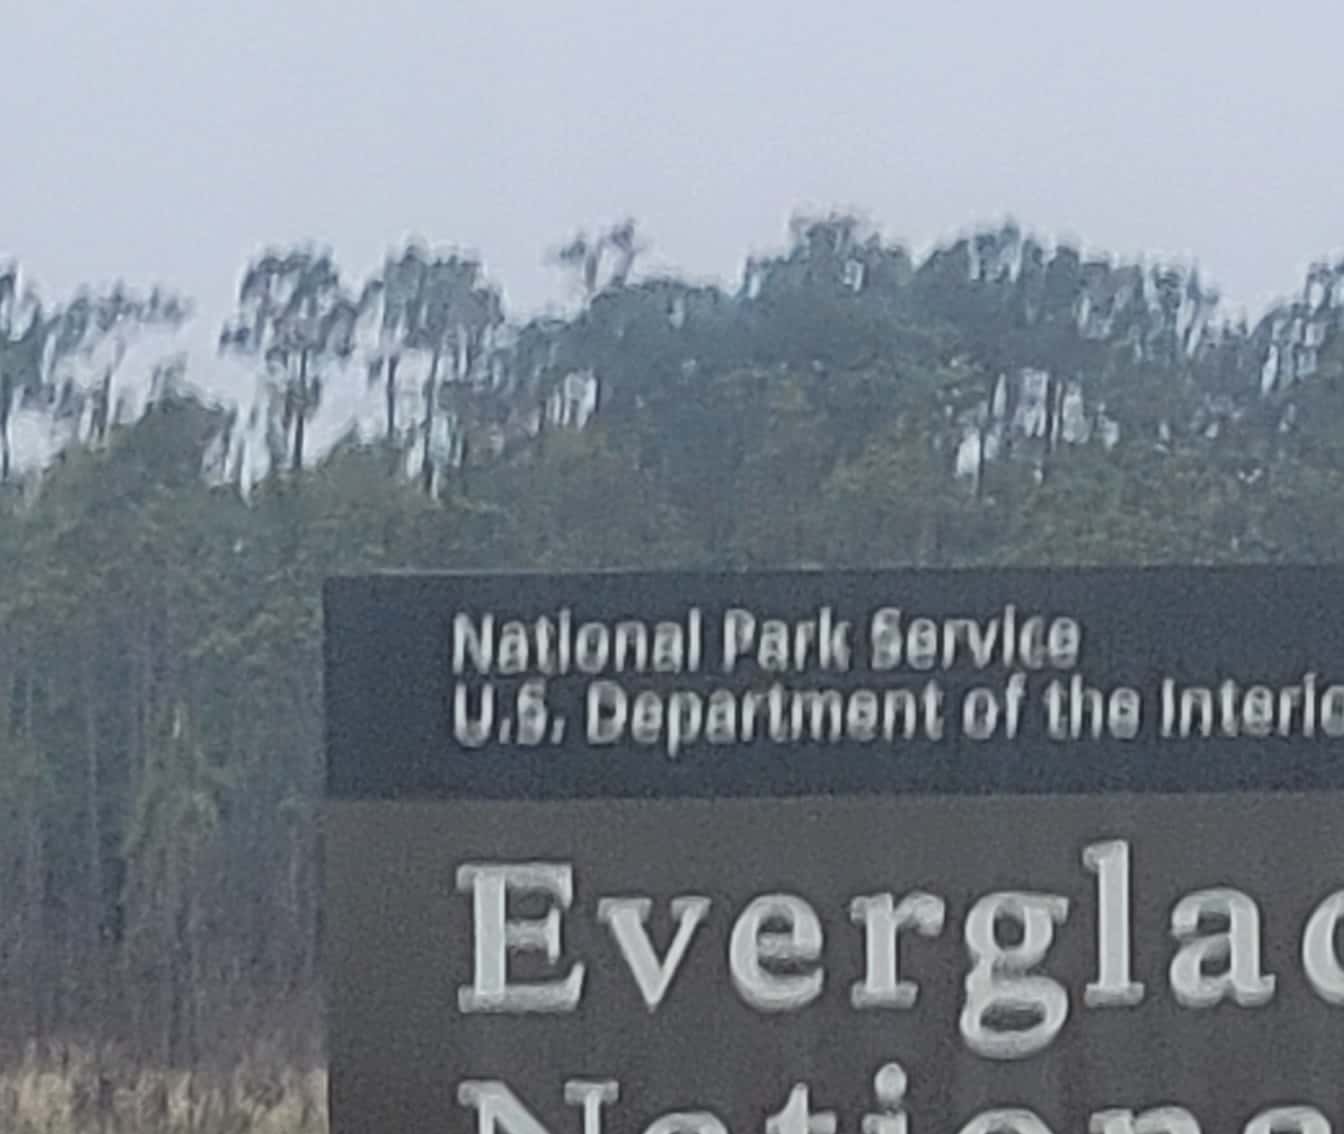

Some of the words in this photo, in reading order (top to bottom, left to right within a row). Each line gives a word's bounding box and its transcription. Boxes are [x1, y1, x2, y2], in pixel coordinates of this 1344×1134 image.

[450, 609, 700, 674] National
[722, 607, 849, 669] Park
[870, 605, 1081, 670] Service
[452, 682, 566, 747] U.S.
[586, 680, 944, 757] Department
[962, 674, 1025, 740] of
[1043, 674, 1141, 739] the
